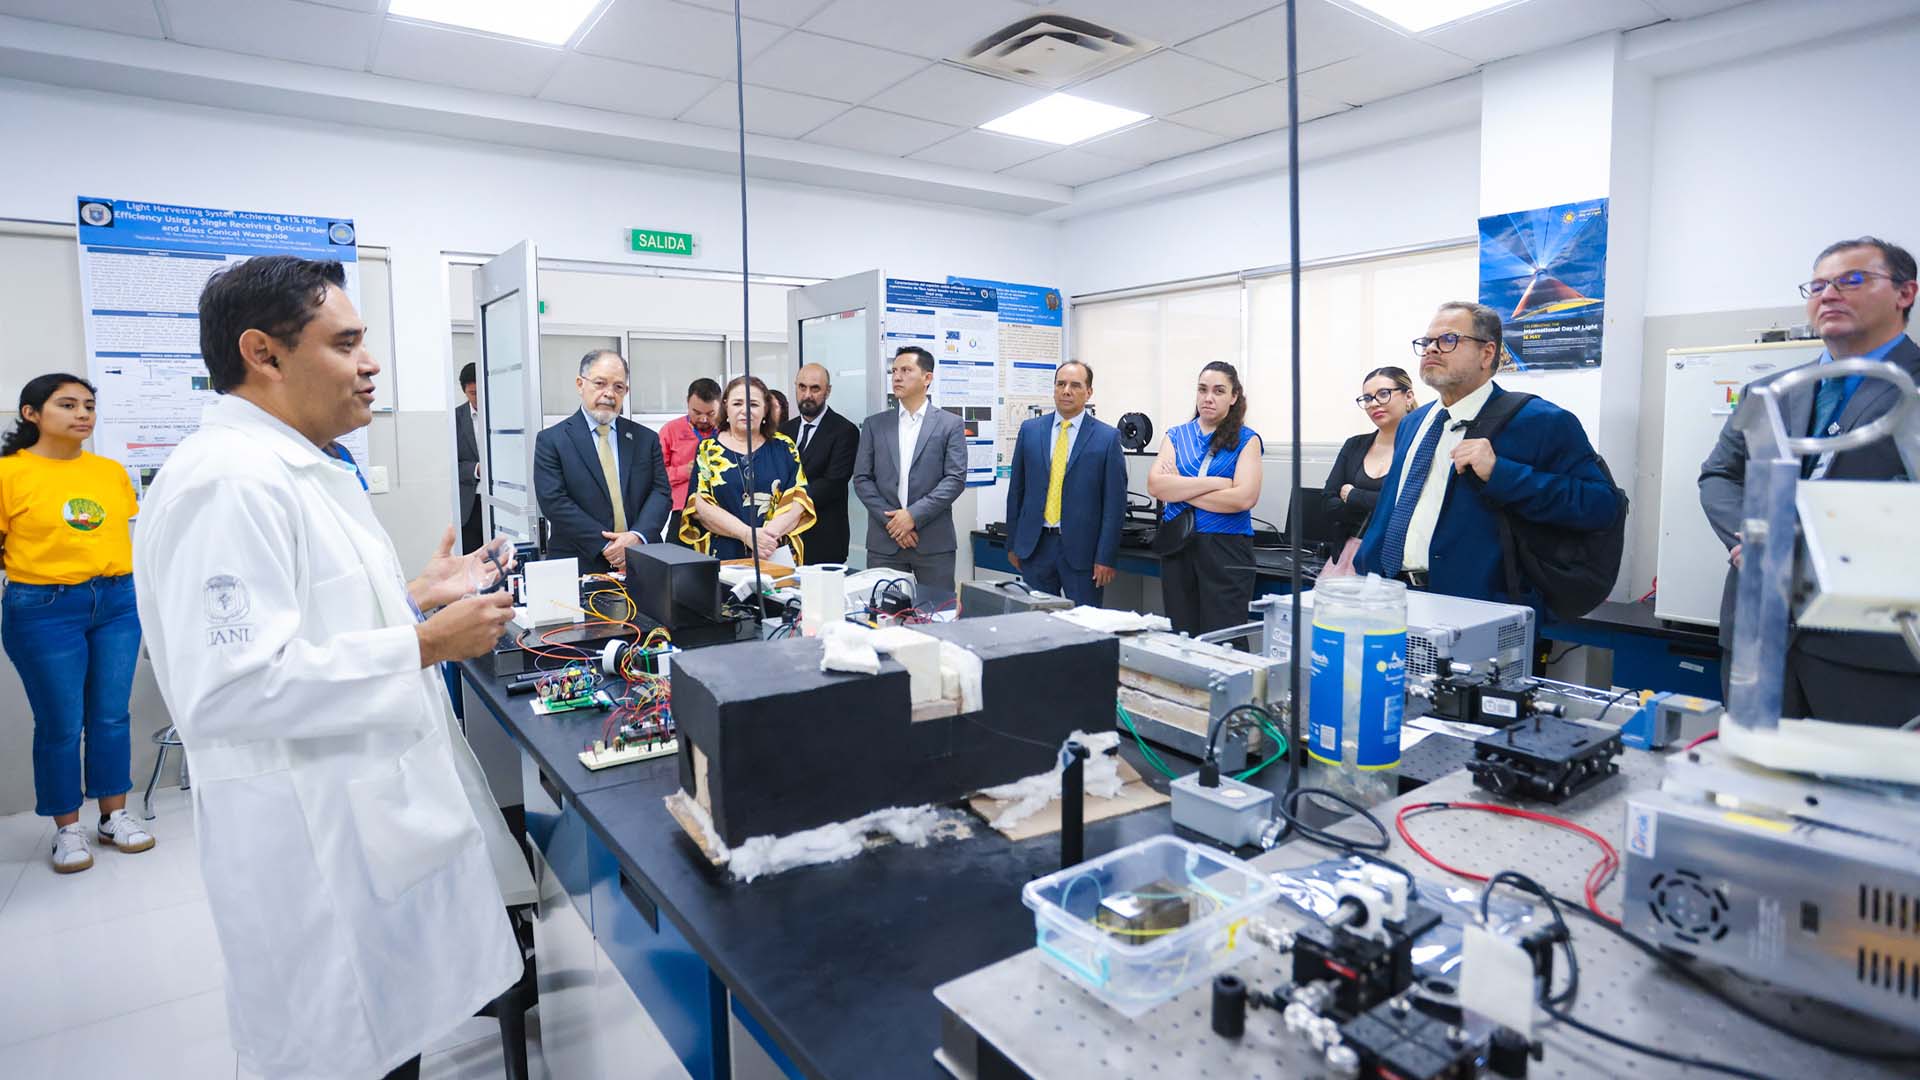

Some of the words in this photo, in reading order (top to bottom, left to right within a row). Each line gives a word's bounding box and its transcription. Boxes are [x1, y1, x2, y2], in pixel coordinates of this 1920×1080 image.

[114, 211, 162, 223] Efficiency
[164, 216, 190, 225] Using
[200, 218, 227, 228] Single
[230, 221, 272, 231] Receiving
[274, 224, 304, 233] Optical
[306, 226, 327, 234] Fiber
[126, 202, 151, 213] Light
[153, 204, 203, 217] Harvesting
[205, 209, 237, 220] System
[238, 213, 281, 223] Achieving
[282, 215, 301, 224] 41%
[302, 217, 317, 225] Net
[181, 226, 205, 234] Glass
[207, 227, 240, 236] Conical
[242, 231, 288, 240] Waveguide
[639, 233, 686, 251] SALIDA
